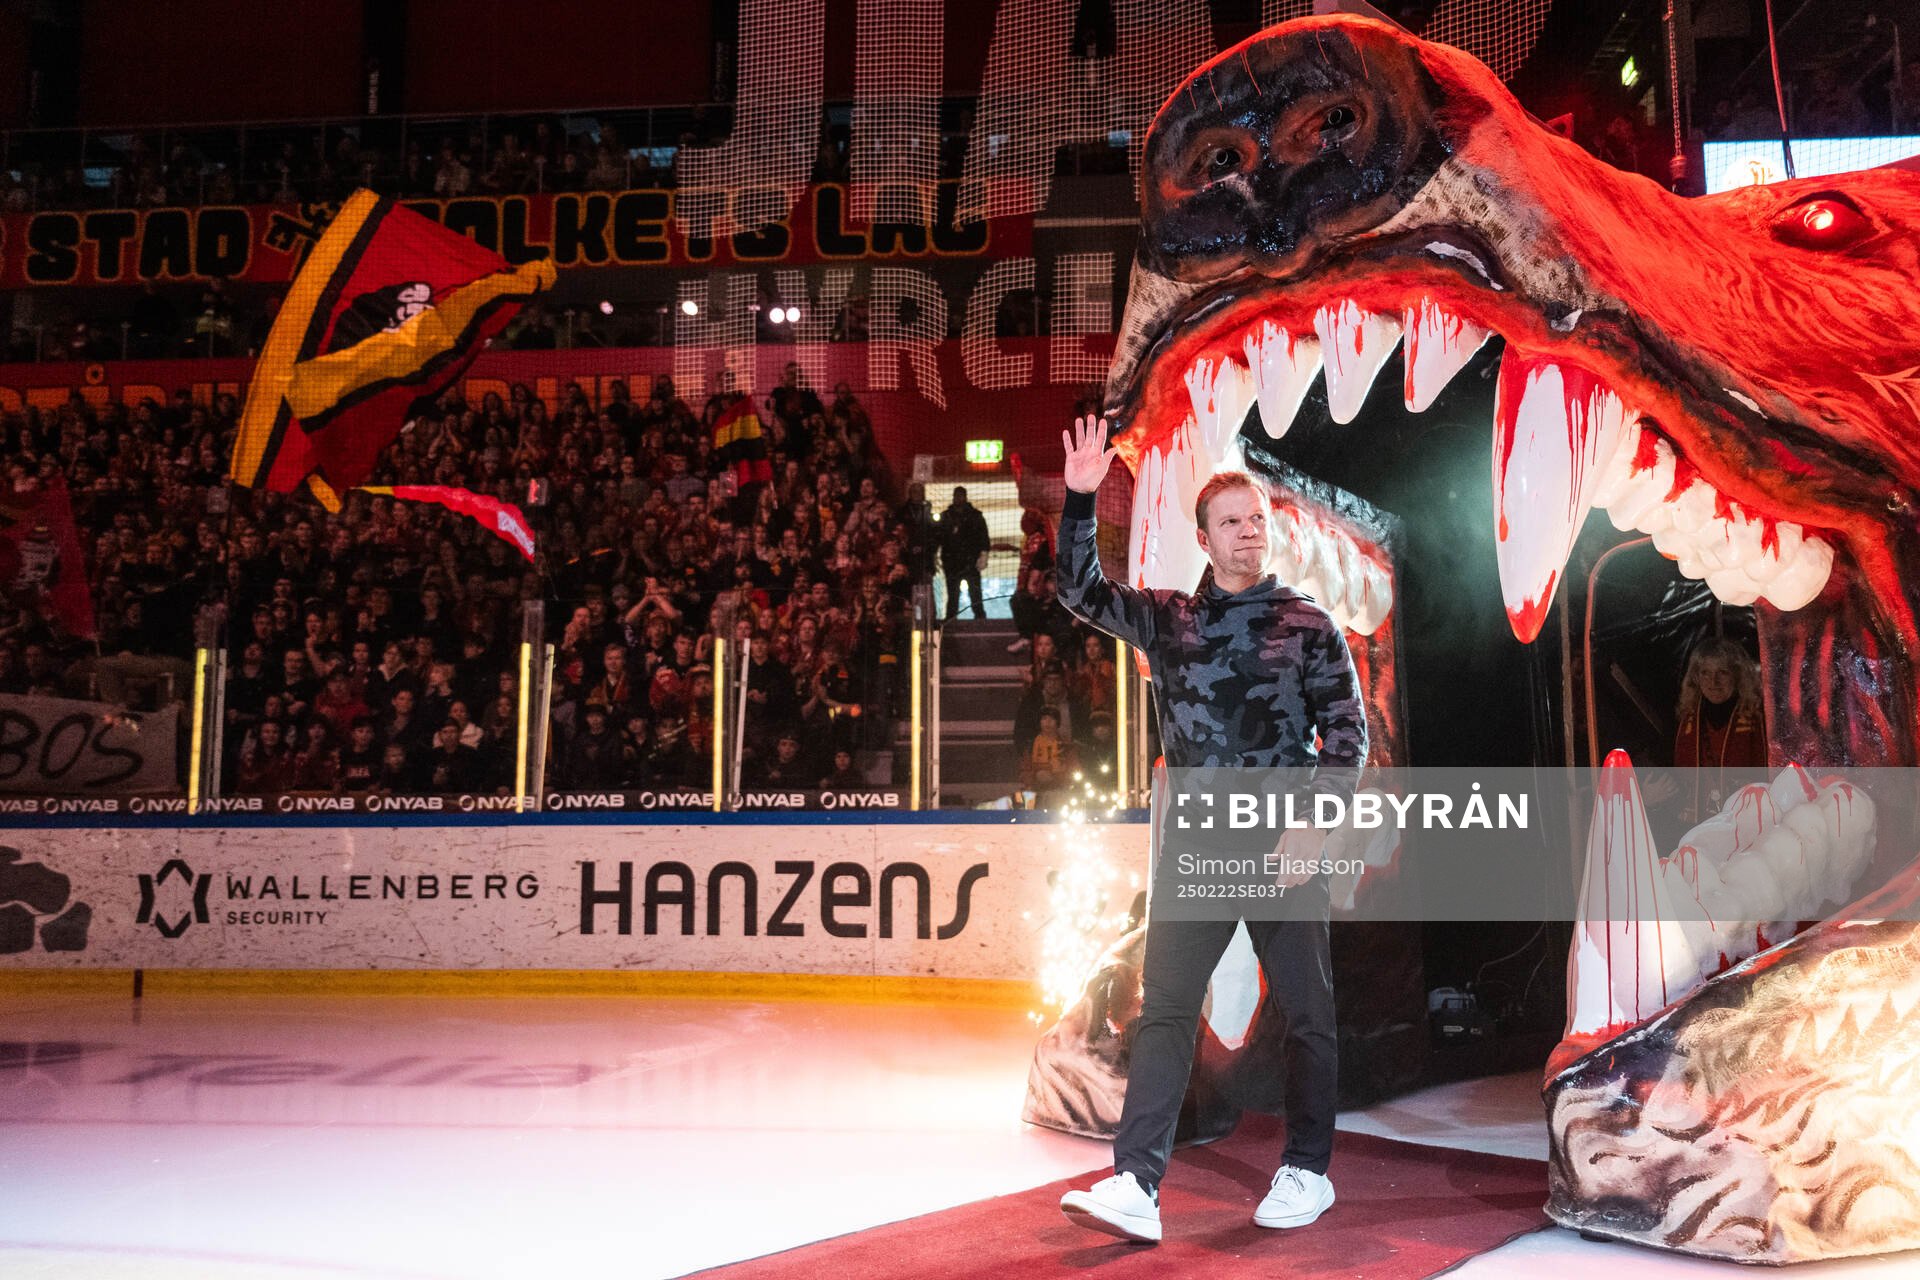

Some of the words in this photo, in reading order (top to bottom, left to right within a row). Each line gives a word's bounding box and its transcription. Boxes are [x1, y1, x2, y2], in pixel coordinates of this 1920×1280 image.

[26, 206, 253, 285] STAD
[397, 184, 793, 268] OLKETS
[812, 177, 991, 261] LAG
[61, 799, 119, 812] NYAB
[206, 798, 263, 811] NYAB
[296, 797, 355, 810] NYAB
[385, 796, 444, 809] NYAB
[565, 793, 624, 807] NYAB
[745, 793, 805, 807] NYAB
[839, 792, 899, 806] NYAB
[227, 873, 540, 900] WALLENBERG
[227, 910, 327, 925] SECURITY
